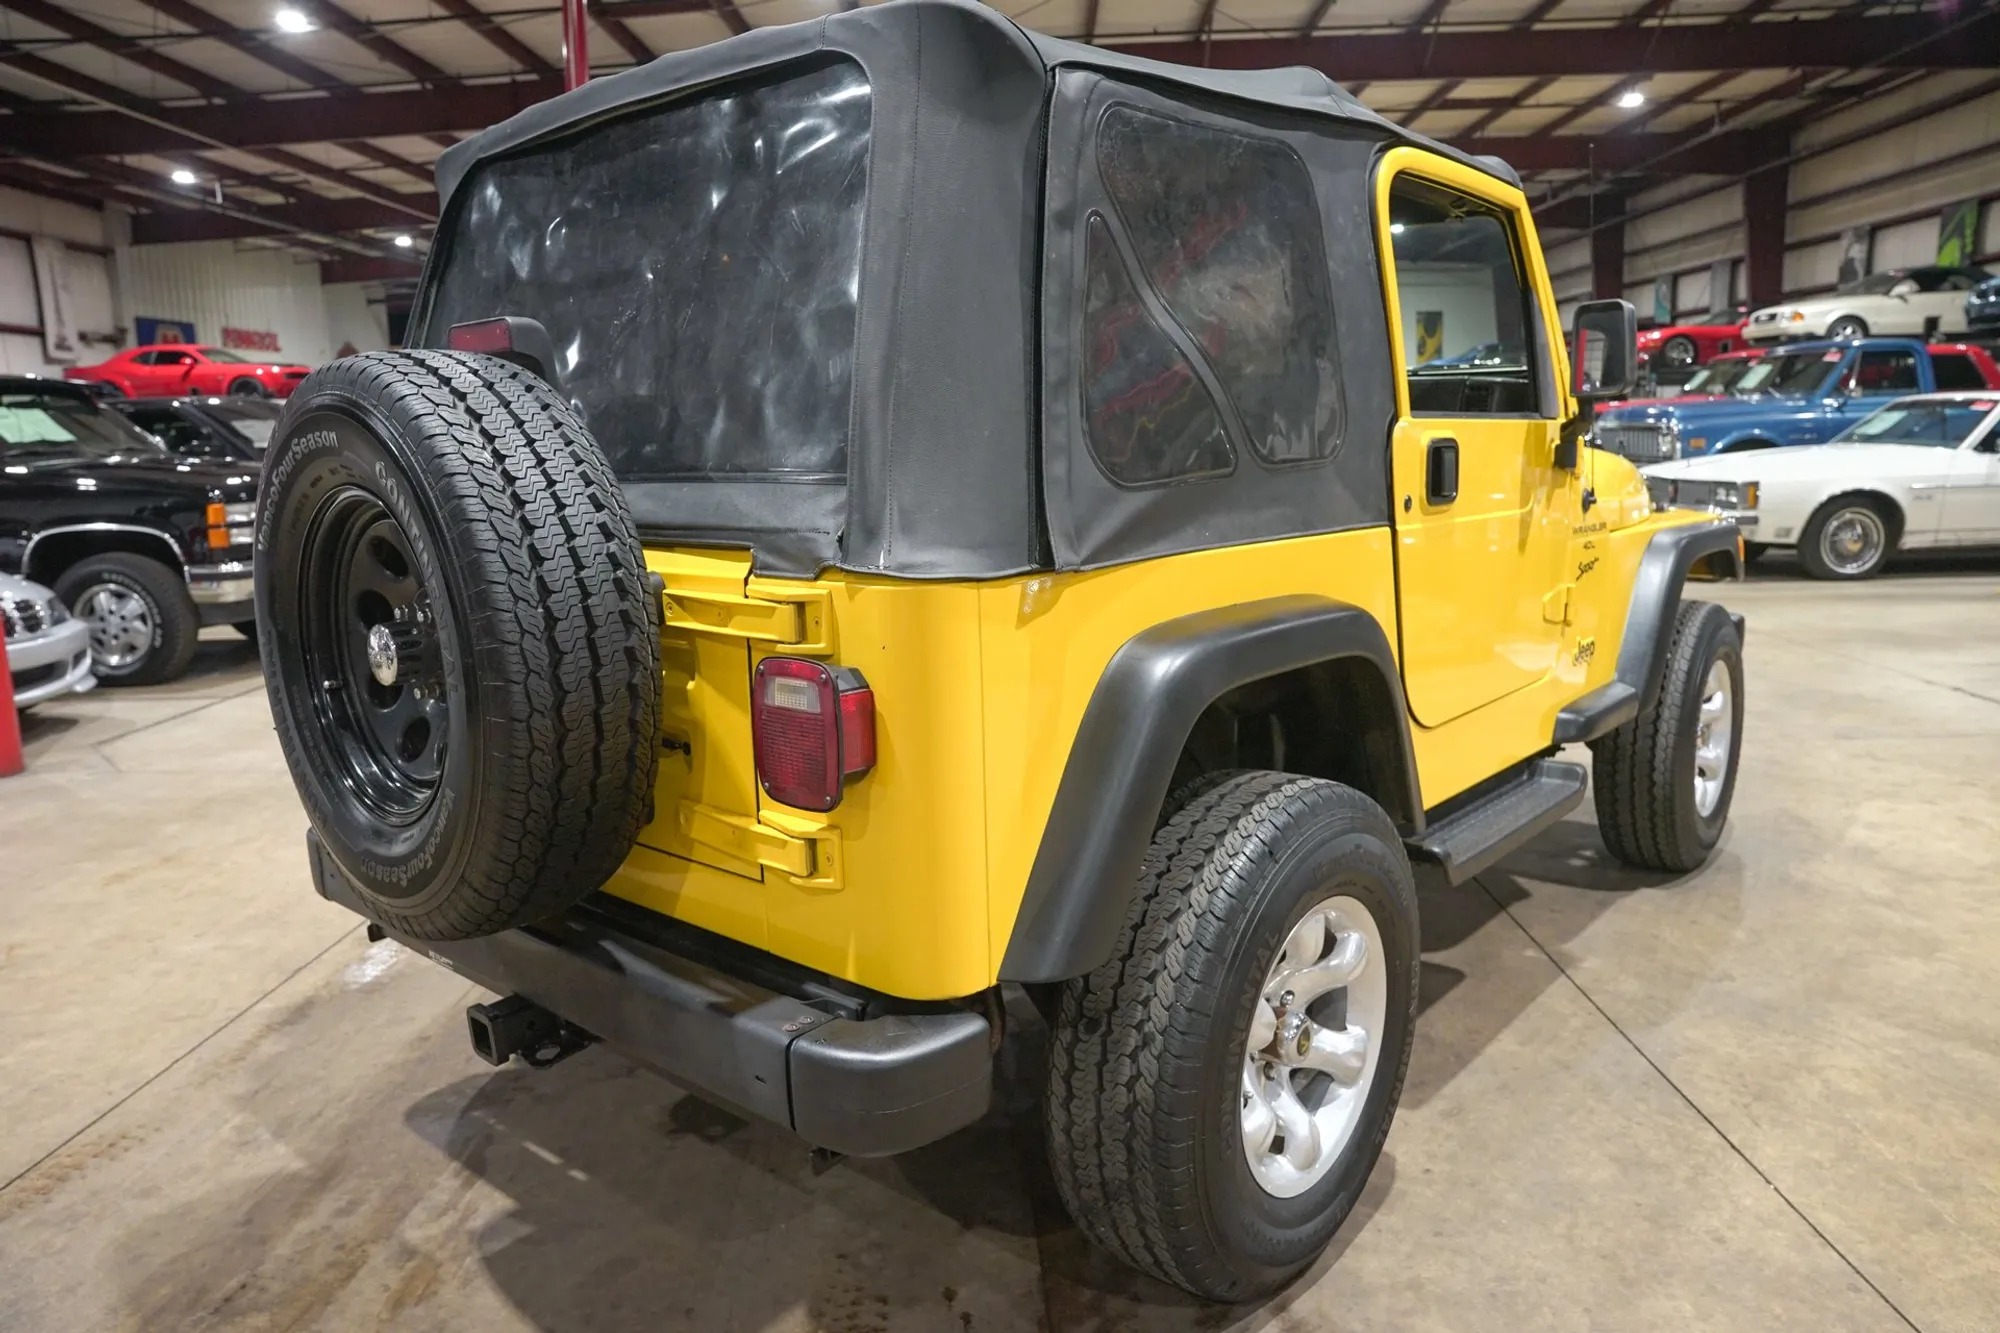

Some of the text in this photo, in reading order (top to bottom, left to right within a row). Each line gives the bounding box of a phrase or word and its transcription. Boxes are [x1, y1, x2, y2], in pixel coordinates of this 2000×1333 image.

[257, 430, 339, 552] VancoFourSeason
[1572, 522, 1607, 535] WRANGLER
[374, 459, 459, 699] CONTINENTAL
[1572, 640, 1595, 667] Jeep
